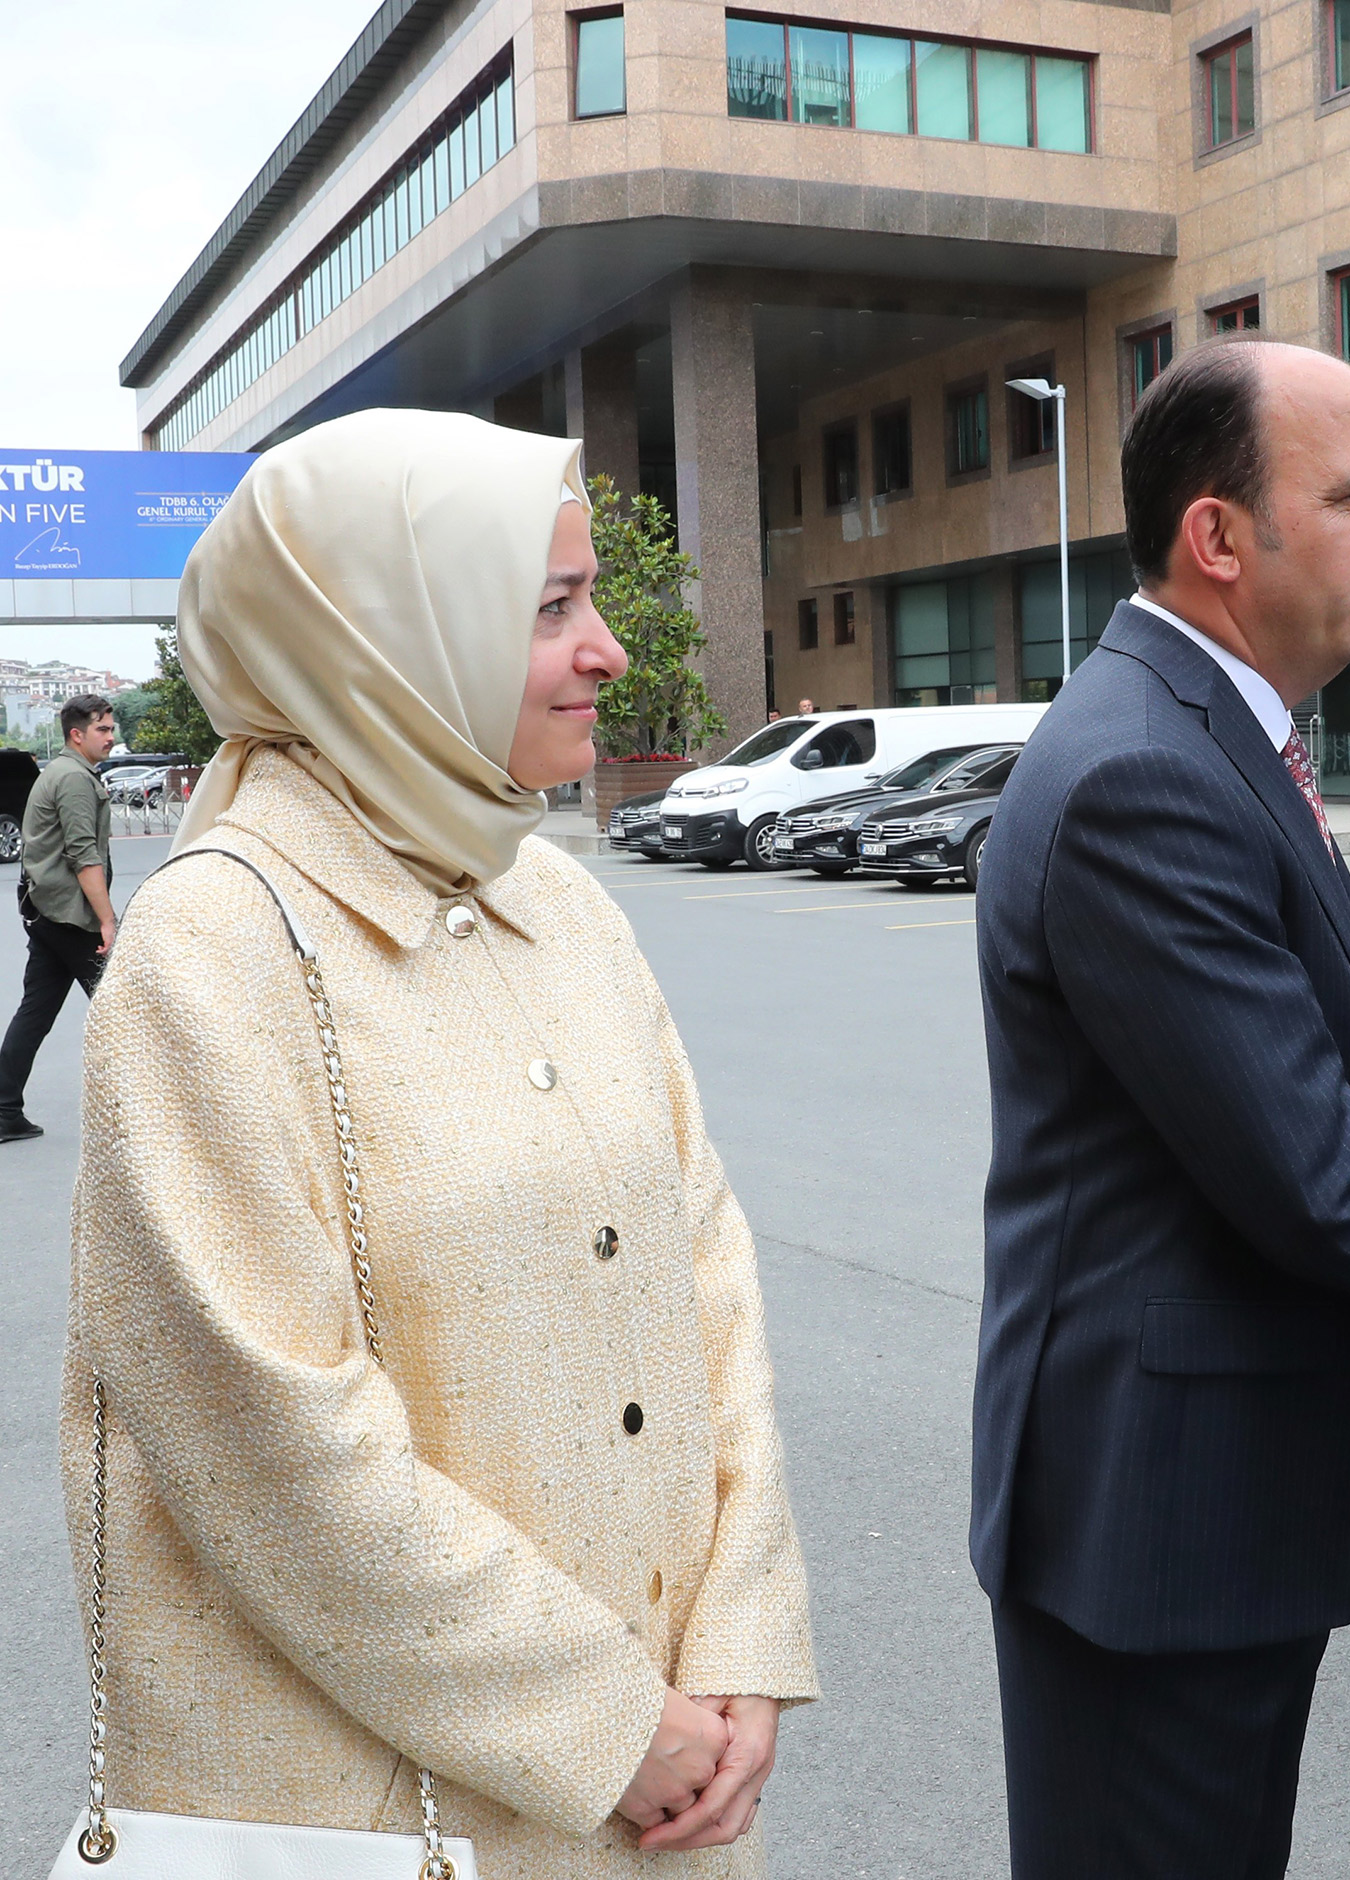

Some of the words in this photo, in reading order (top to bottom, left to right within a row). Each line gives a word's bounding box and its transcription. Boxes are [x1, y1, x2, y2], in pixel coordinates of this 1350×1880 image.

[160, 497, 187, 506] TDBB
[190, 497, 199, 506] 6.
[26, 503, 86, 523] FIVE
[137, 507, 171, 516] GENEL
[174, 507, 208, 516] KURUL
